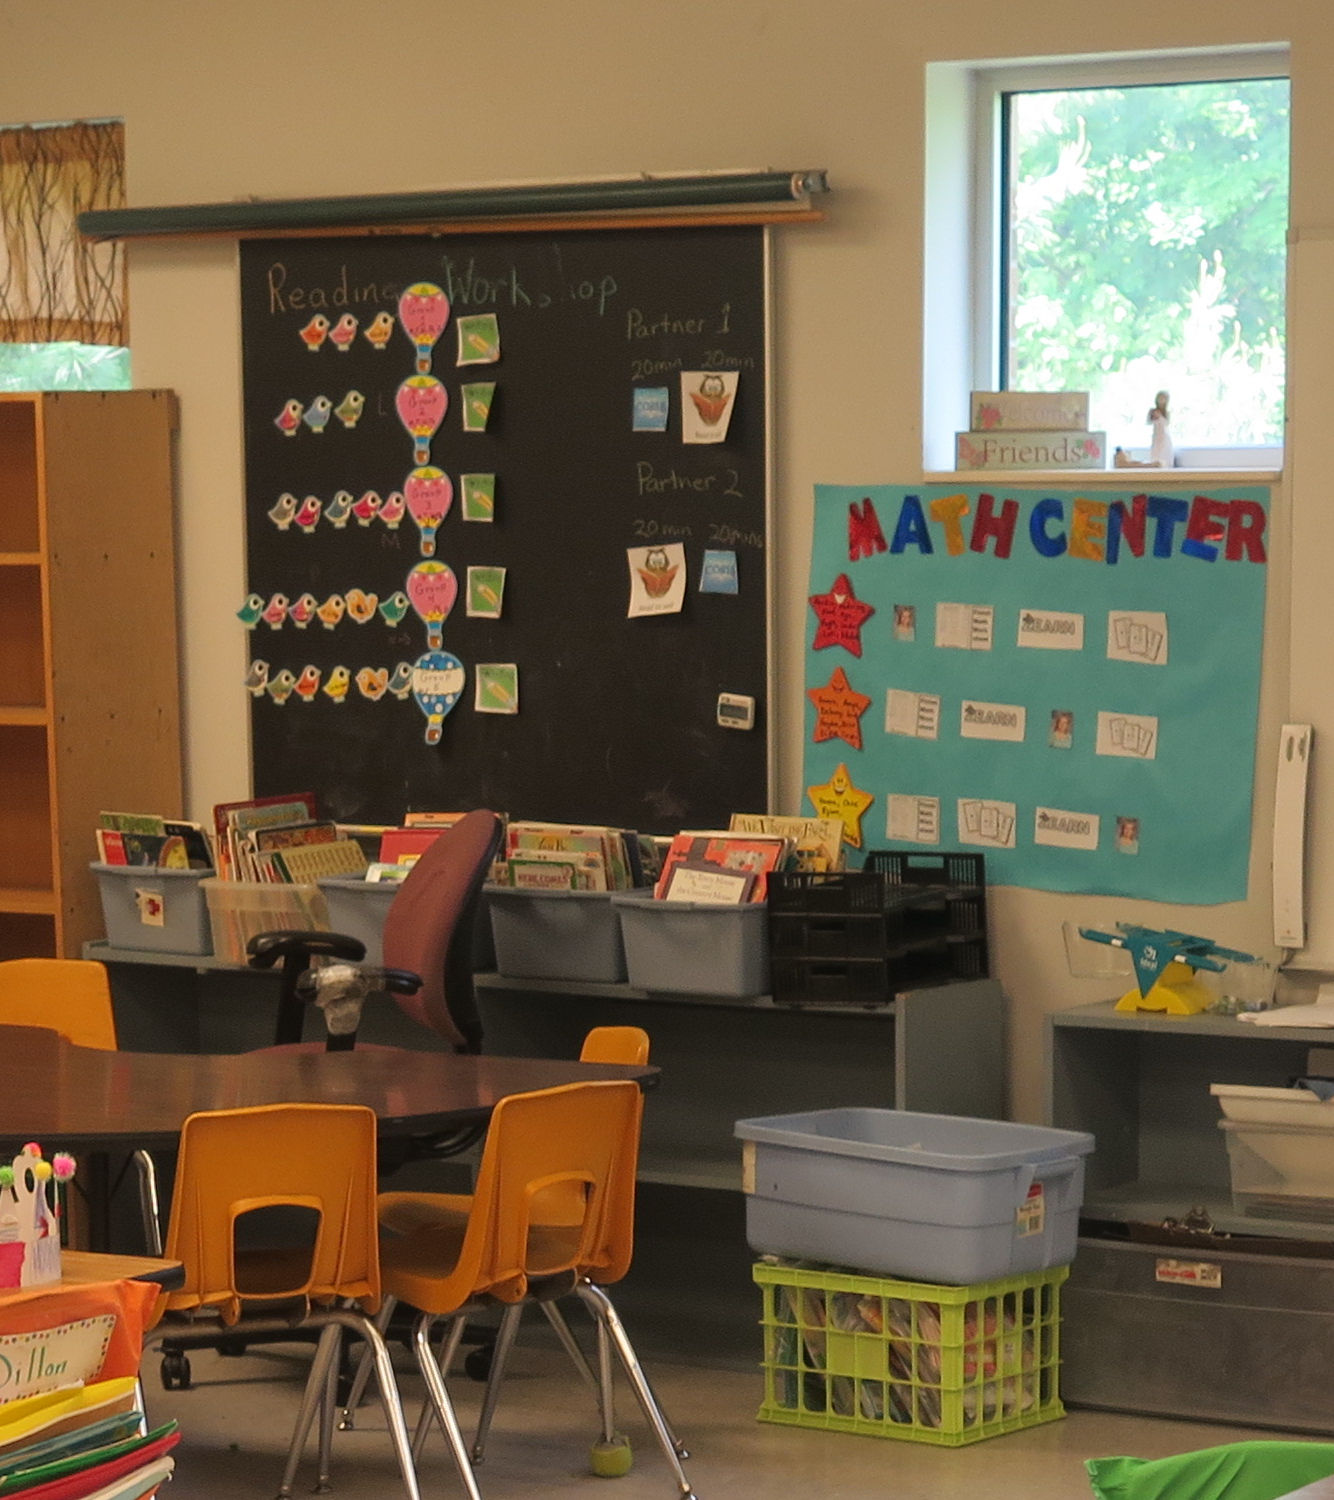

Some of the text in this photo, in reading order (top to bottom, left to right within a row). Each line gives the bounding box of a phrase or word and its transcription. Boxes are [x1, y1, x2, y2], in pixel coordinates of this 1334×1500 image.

[628, 308, 705, 340] Partner
[982, 437, 1081, 464] Friends
[637, 461, 744, 497] Partner 2
[847, 493, 1267, 565] MATH CENTER
